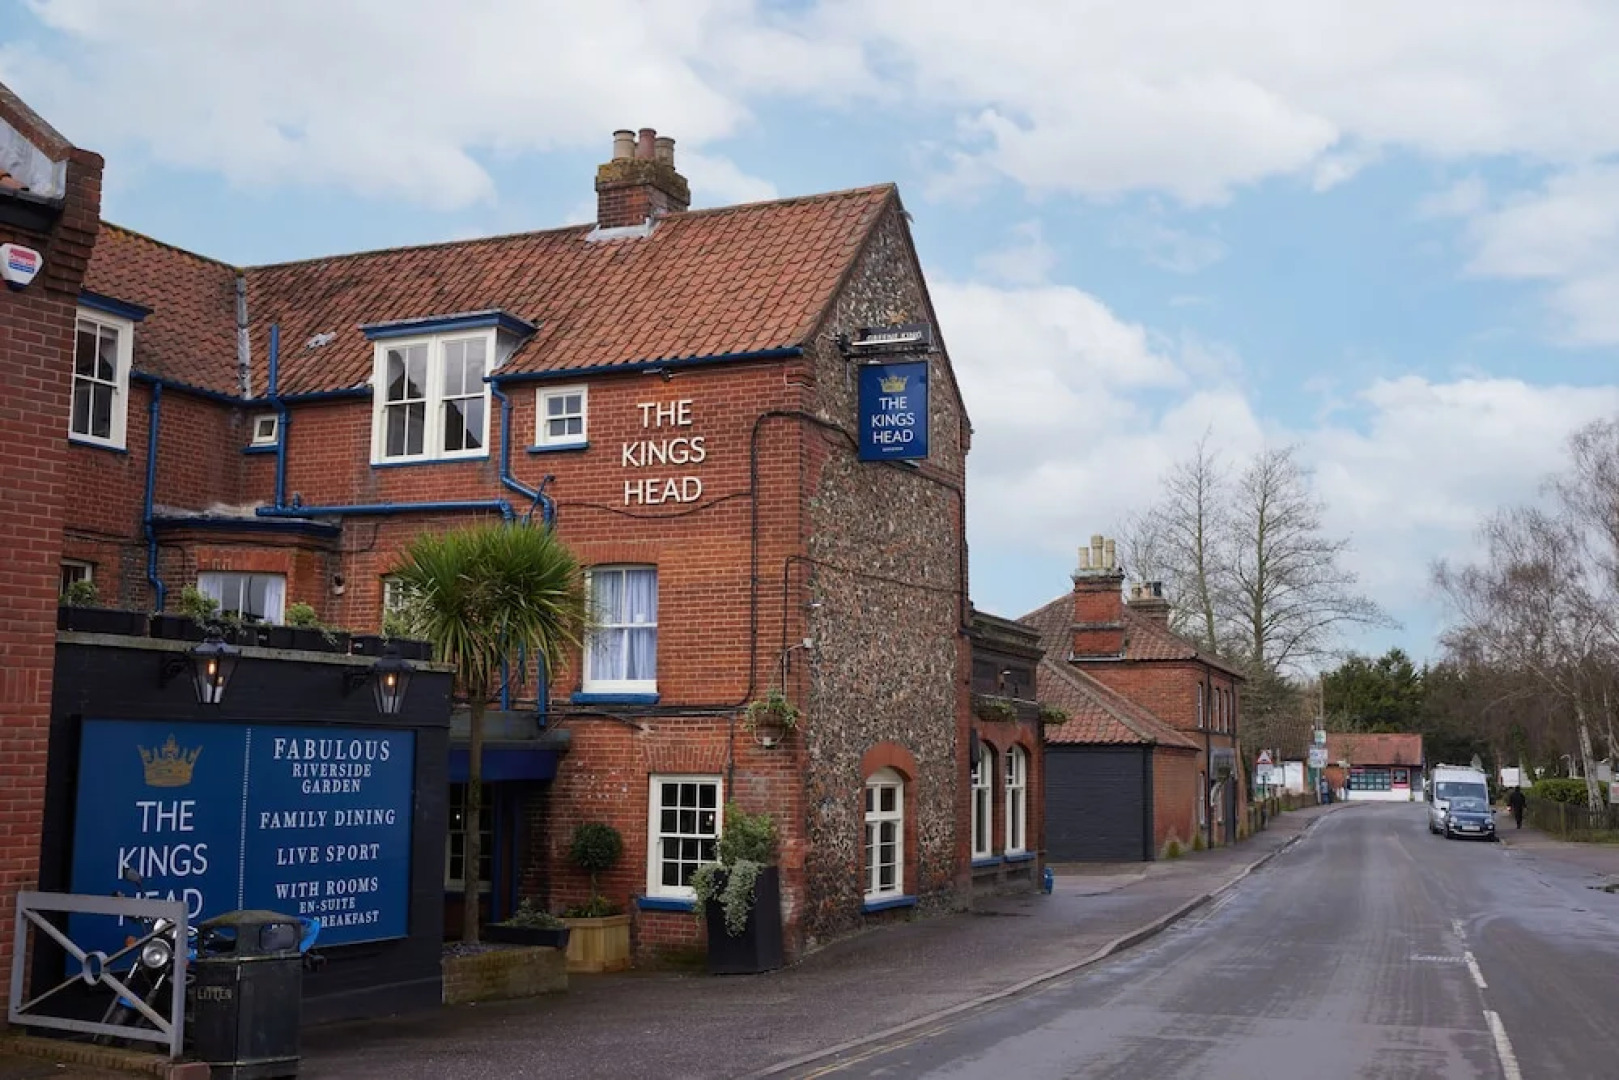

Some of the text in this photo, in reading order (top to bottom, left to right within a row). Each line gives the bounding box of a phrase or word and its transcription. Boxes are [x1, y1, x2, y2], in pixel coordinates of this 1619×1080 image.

[637, 400, 692, 428] THE
[879, 396, 907, 410] THE
[872, 412, 915, 427] KINGS
[873, 429, 914, 444] HEAD
[622, 437, 706, 467] KINGS
[624, 477, 702, 505] HEAD
[273, 738, 390, 761] FABULOUS
[292, 763, 372, 778] RIVERSIDE
[302, 779, 361, 794] GARDEN
[136, 800, 195, 832] THE
[260, 809, 396, 829] FAMILY DINING
[118, 843, 208, 879] KINGS
[277, 843, 380, 866] LIVE SPORT
[276, 877, 378, 899] WITH ROOMS
[299, 897, 356, 914] EN-SUITE
